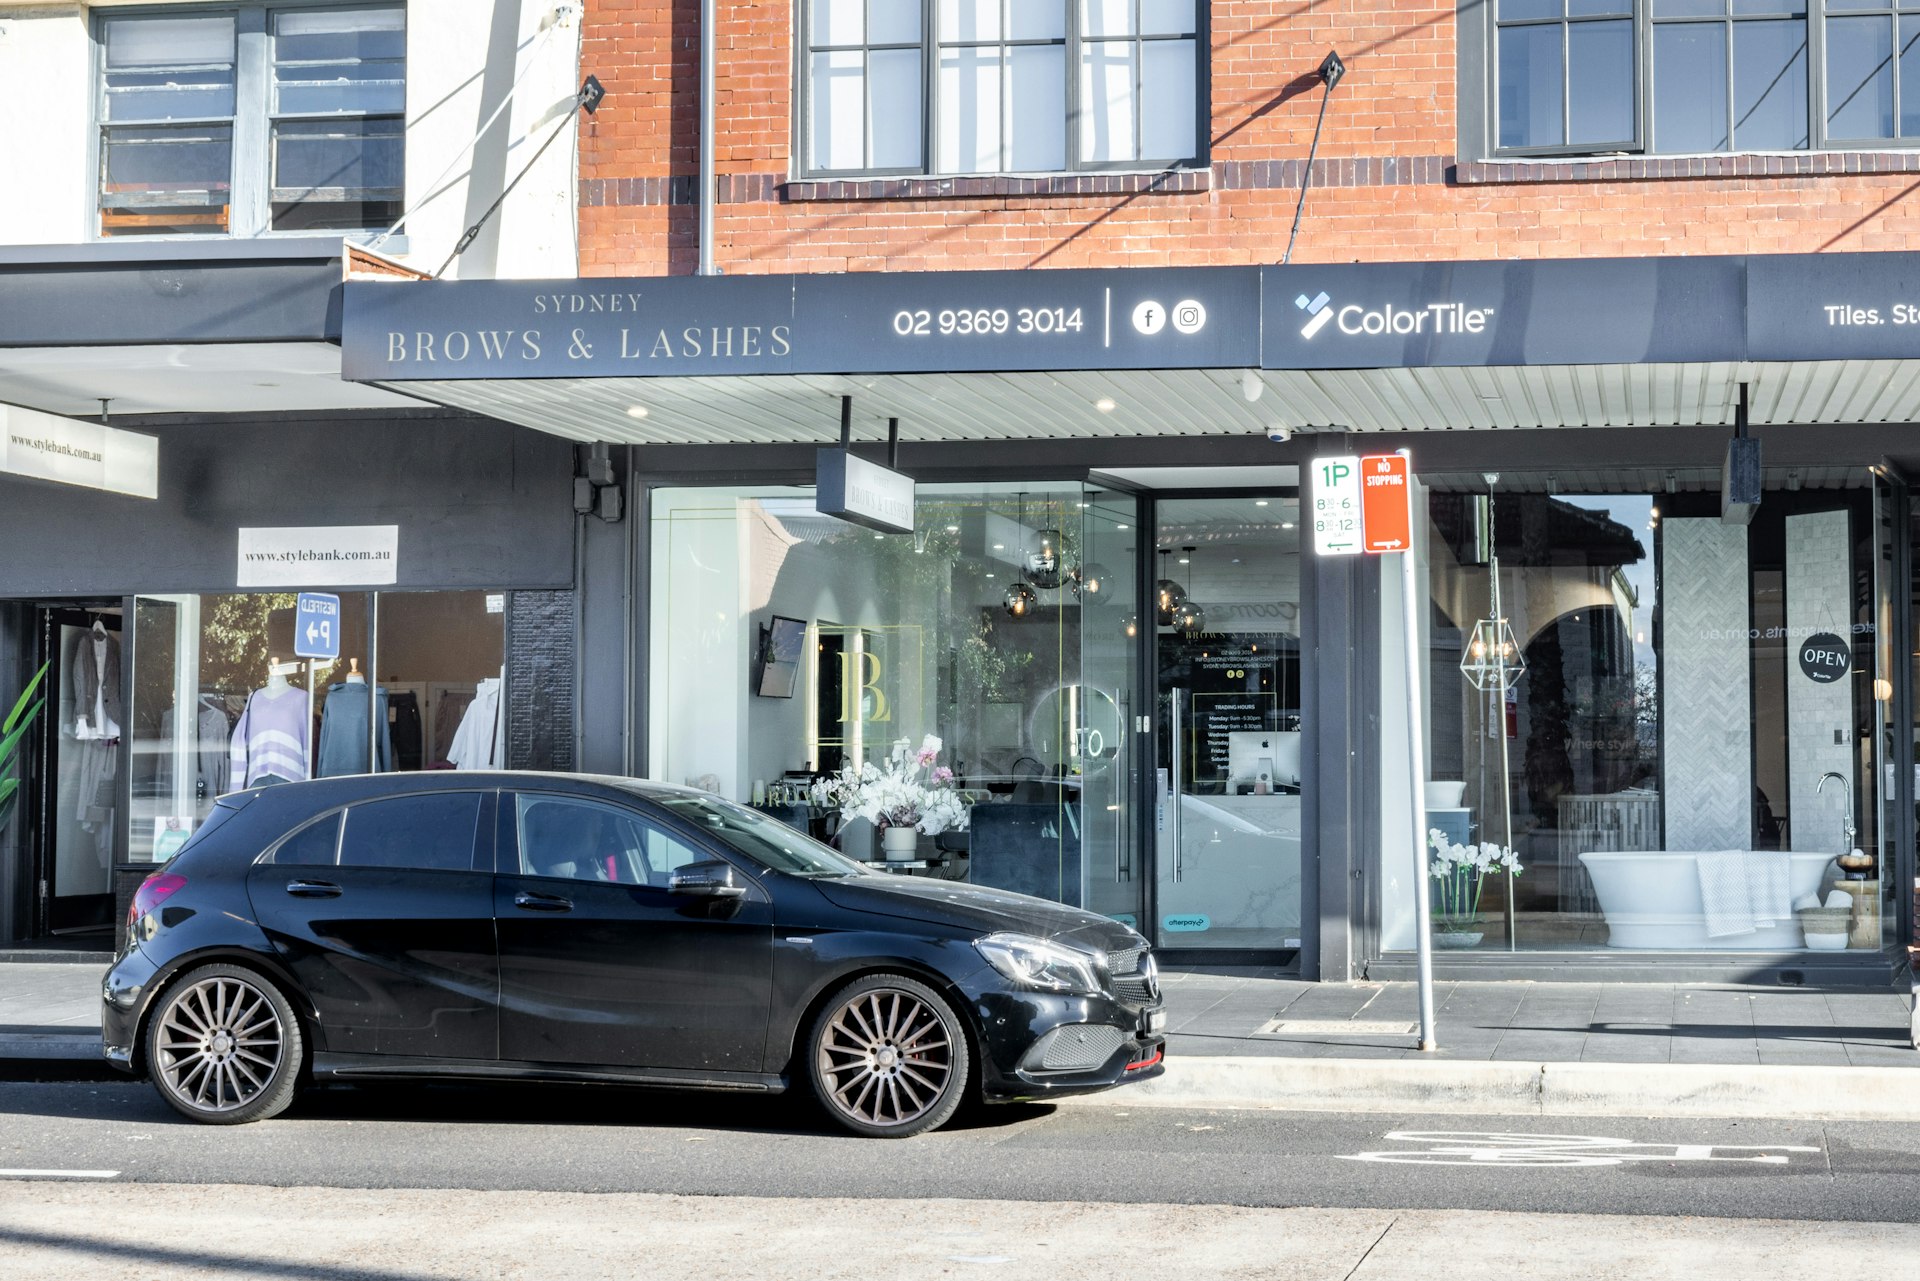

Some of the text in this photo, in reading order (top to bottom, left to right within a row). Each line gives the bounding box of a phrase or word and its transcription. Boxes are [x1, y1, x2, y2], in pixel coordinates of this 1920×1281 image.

[535, 293, 642, 314] SYDNEY
[894, 308, 1084, 336] 02 9369 3014
[1824, 304, 1885, 326] Tiles.
[387, 325, 792, 362] BROWS & LASHES
[11, 434, 102, 462] www.stylebank.com.au
[1323, 464, 1349, 487] 1P
[1377, 462, 1391, 473] NO
[1366, 475, 1403, 486] STOPPING
[245, 549, 391, 564] www.stylebank.com.au
[1185, 631, 1226, 640] BROWS
[1244, 631, 1289, 639] LASHES
[1804, 648, 1847, 668] OPEN
[1168, 919, 1197, 927] afterpay
